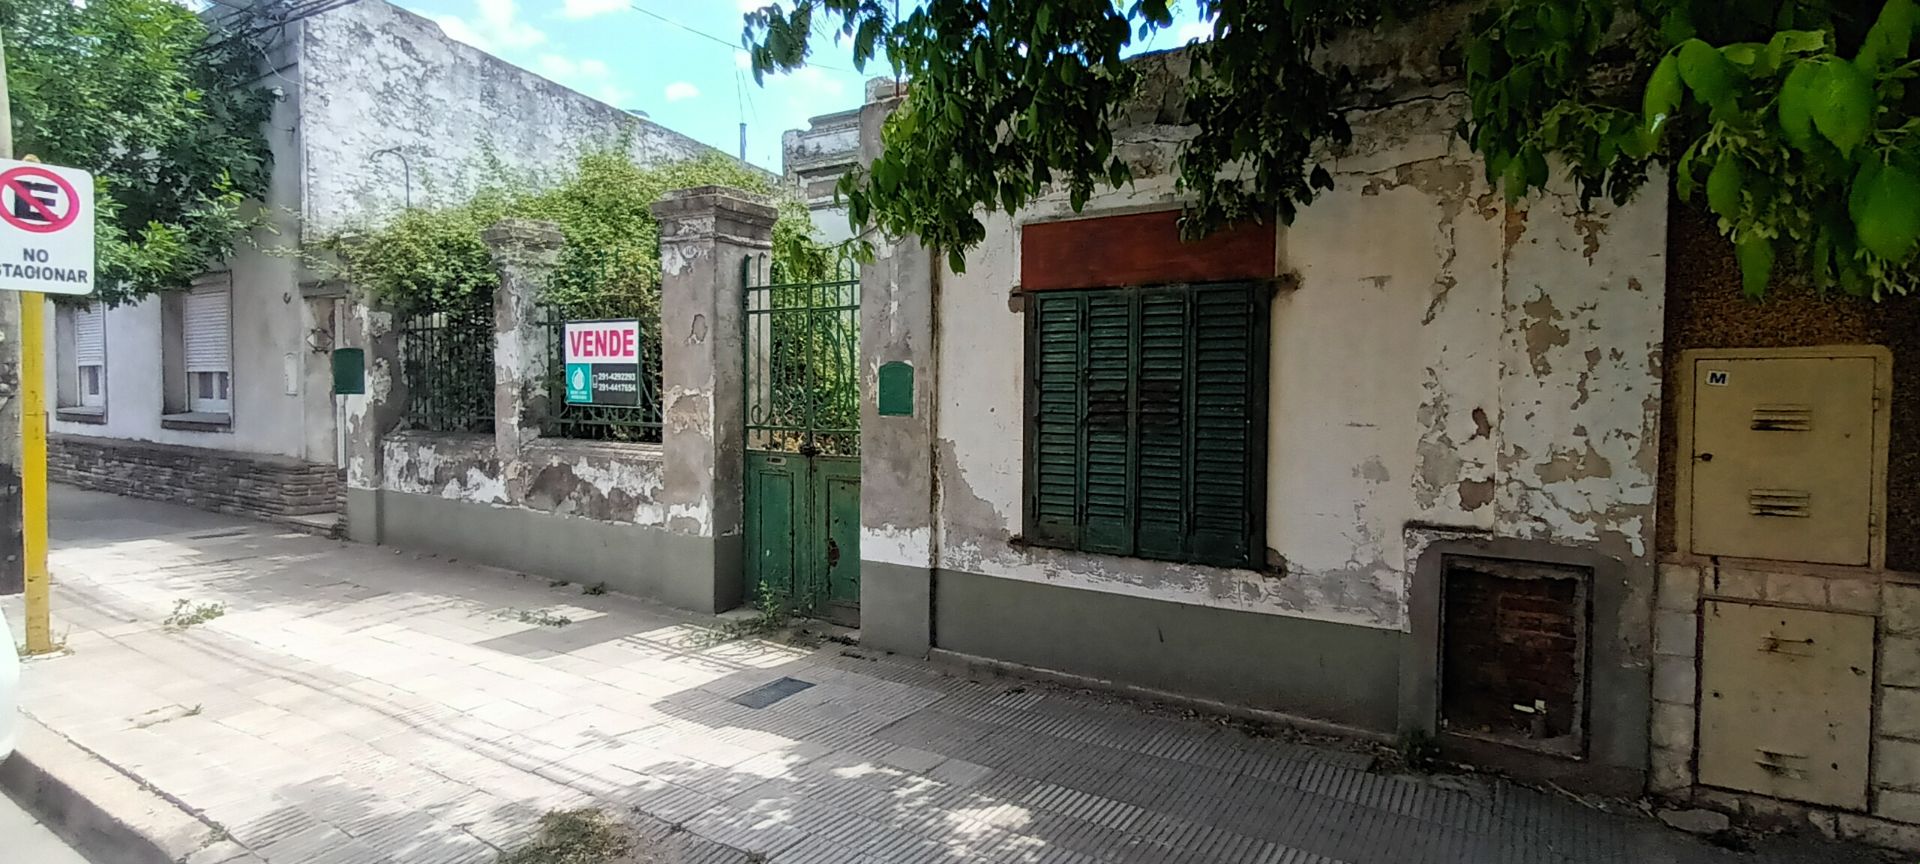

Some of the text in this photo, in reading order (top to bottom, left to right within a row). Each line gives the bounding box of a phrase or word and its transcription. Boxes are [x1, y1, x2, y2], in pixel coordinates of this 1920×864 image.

[13, 179, 59, 222] E
[22, 247, 49, 263] NO
[0, 262, 89, 284] TACIONAR
[569, 329, 635, 358] VENDE
[1709, 372, 1727, 385] M
